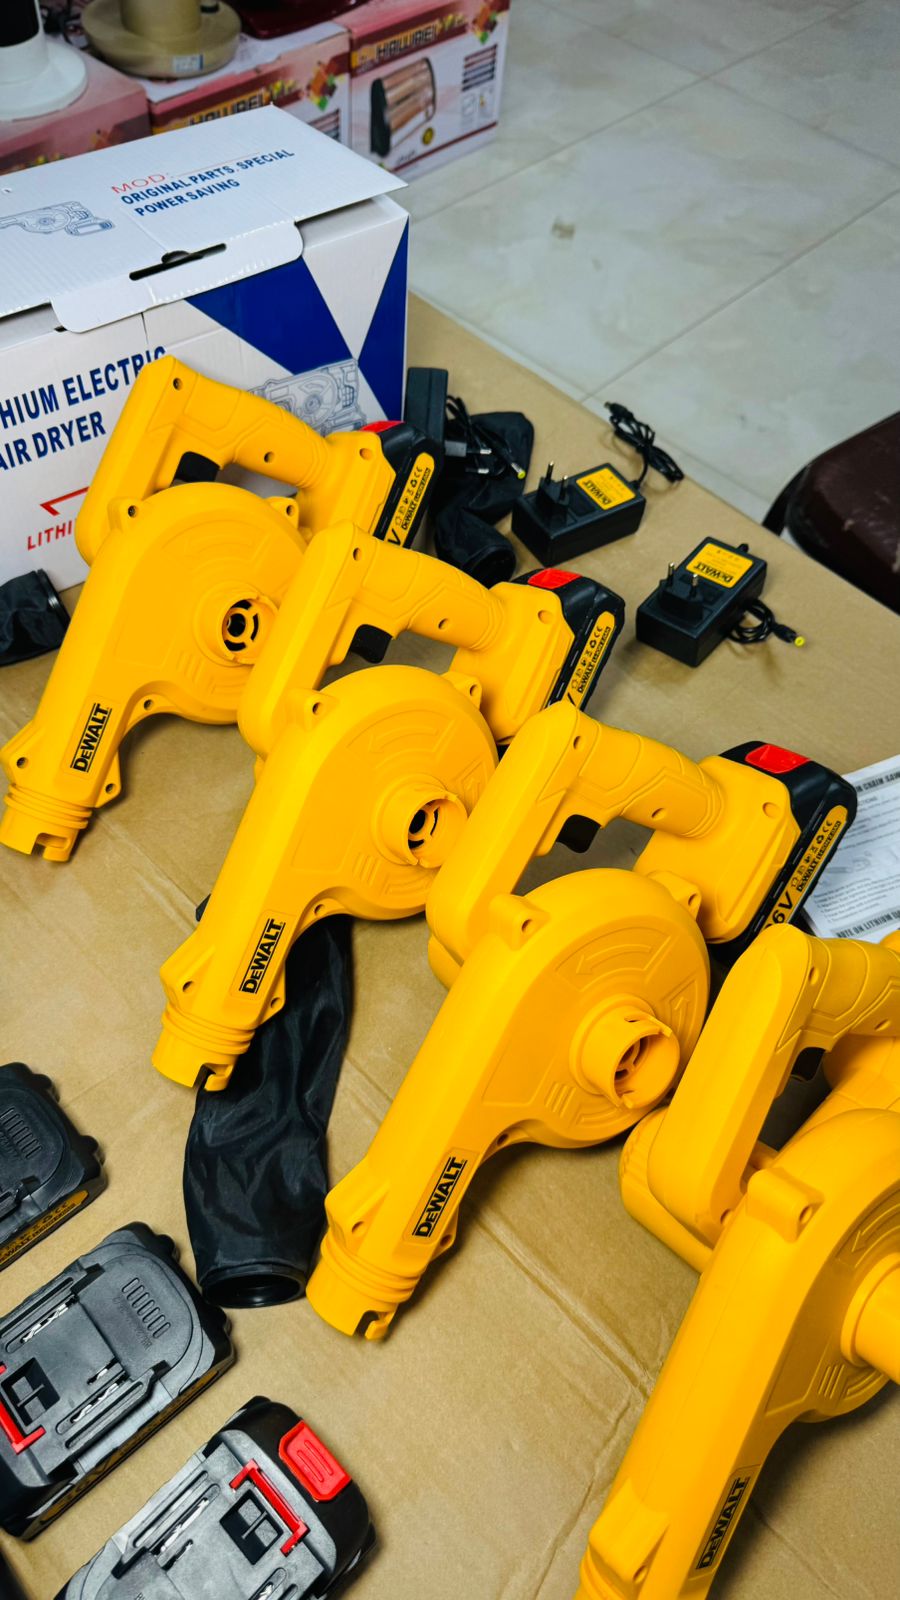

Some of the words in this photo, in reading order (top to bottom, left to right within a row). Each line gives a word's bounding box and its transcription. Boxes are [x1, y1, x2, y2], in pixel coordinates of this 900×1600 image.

[121, 179, 191, 205] ORIGINAL
[236, 149, 295, 170] SPECIAL
[134, 193, 188, 216] POWER
[185, 178, 240, 201] SAVING
[32, 411, 106, 458] DRYER
[27, 519, 73, 551] LITHI
